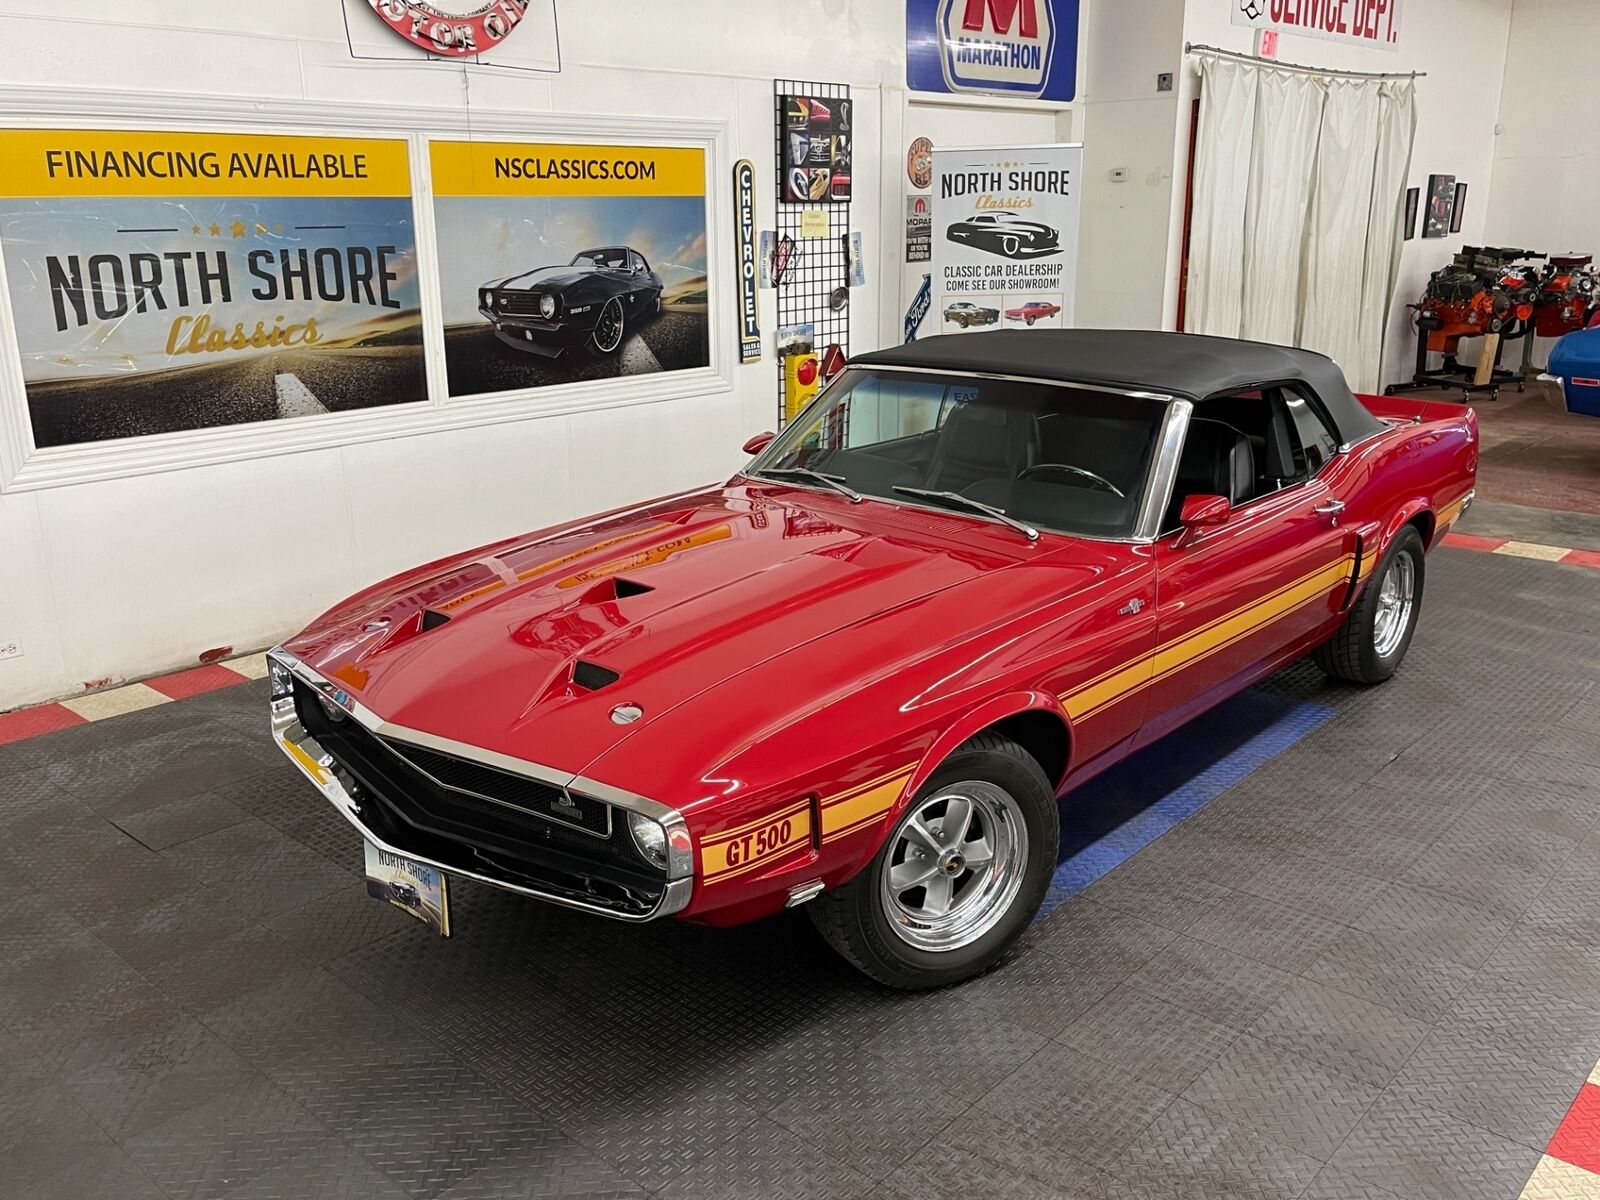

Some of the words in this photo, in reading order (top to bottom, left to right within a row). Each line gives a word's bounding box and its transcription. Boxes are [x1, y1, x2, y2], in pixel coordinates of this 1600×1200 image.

[957, 36, 1041, 70] MARATHON
[46, 150, 221, 178] FINANCING
[228, 153, 368, 178] AVAILABLE
[494, 157, 656, 180] NSCLASSICS.COM
[941, 172, 1002, 199] NORTH
[1008, 170, 1070, 195] SHORE
[975, 194, 1034, 209] Classics
[740, 170, 753, 333] CHEVROLET
[944, 265, 982, 278] CLASSIC
[984, 265, 1003, 277] CAR
[1005, 263, 1063, 276] DEALERSHIP
[946, 280, 969, 291] COME
[971, 280, 987, 291] SEE
[989, 279, 1006, 290] OUR
[1007, 278, 1060, 290] SHOWROOM!
[46, 250, 232, 332] NORTH
[248, 246, 400, 309] SHORE
[165, 314, 324, 355] Classics
[726, 835, 753, 867] GT
[756, 820, 791, 856] 500
[378, 850, 406, 871] NORTH
[407, 862, 432, 891] SHORE
